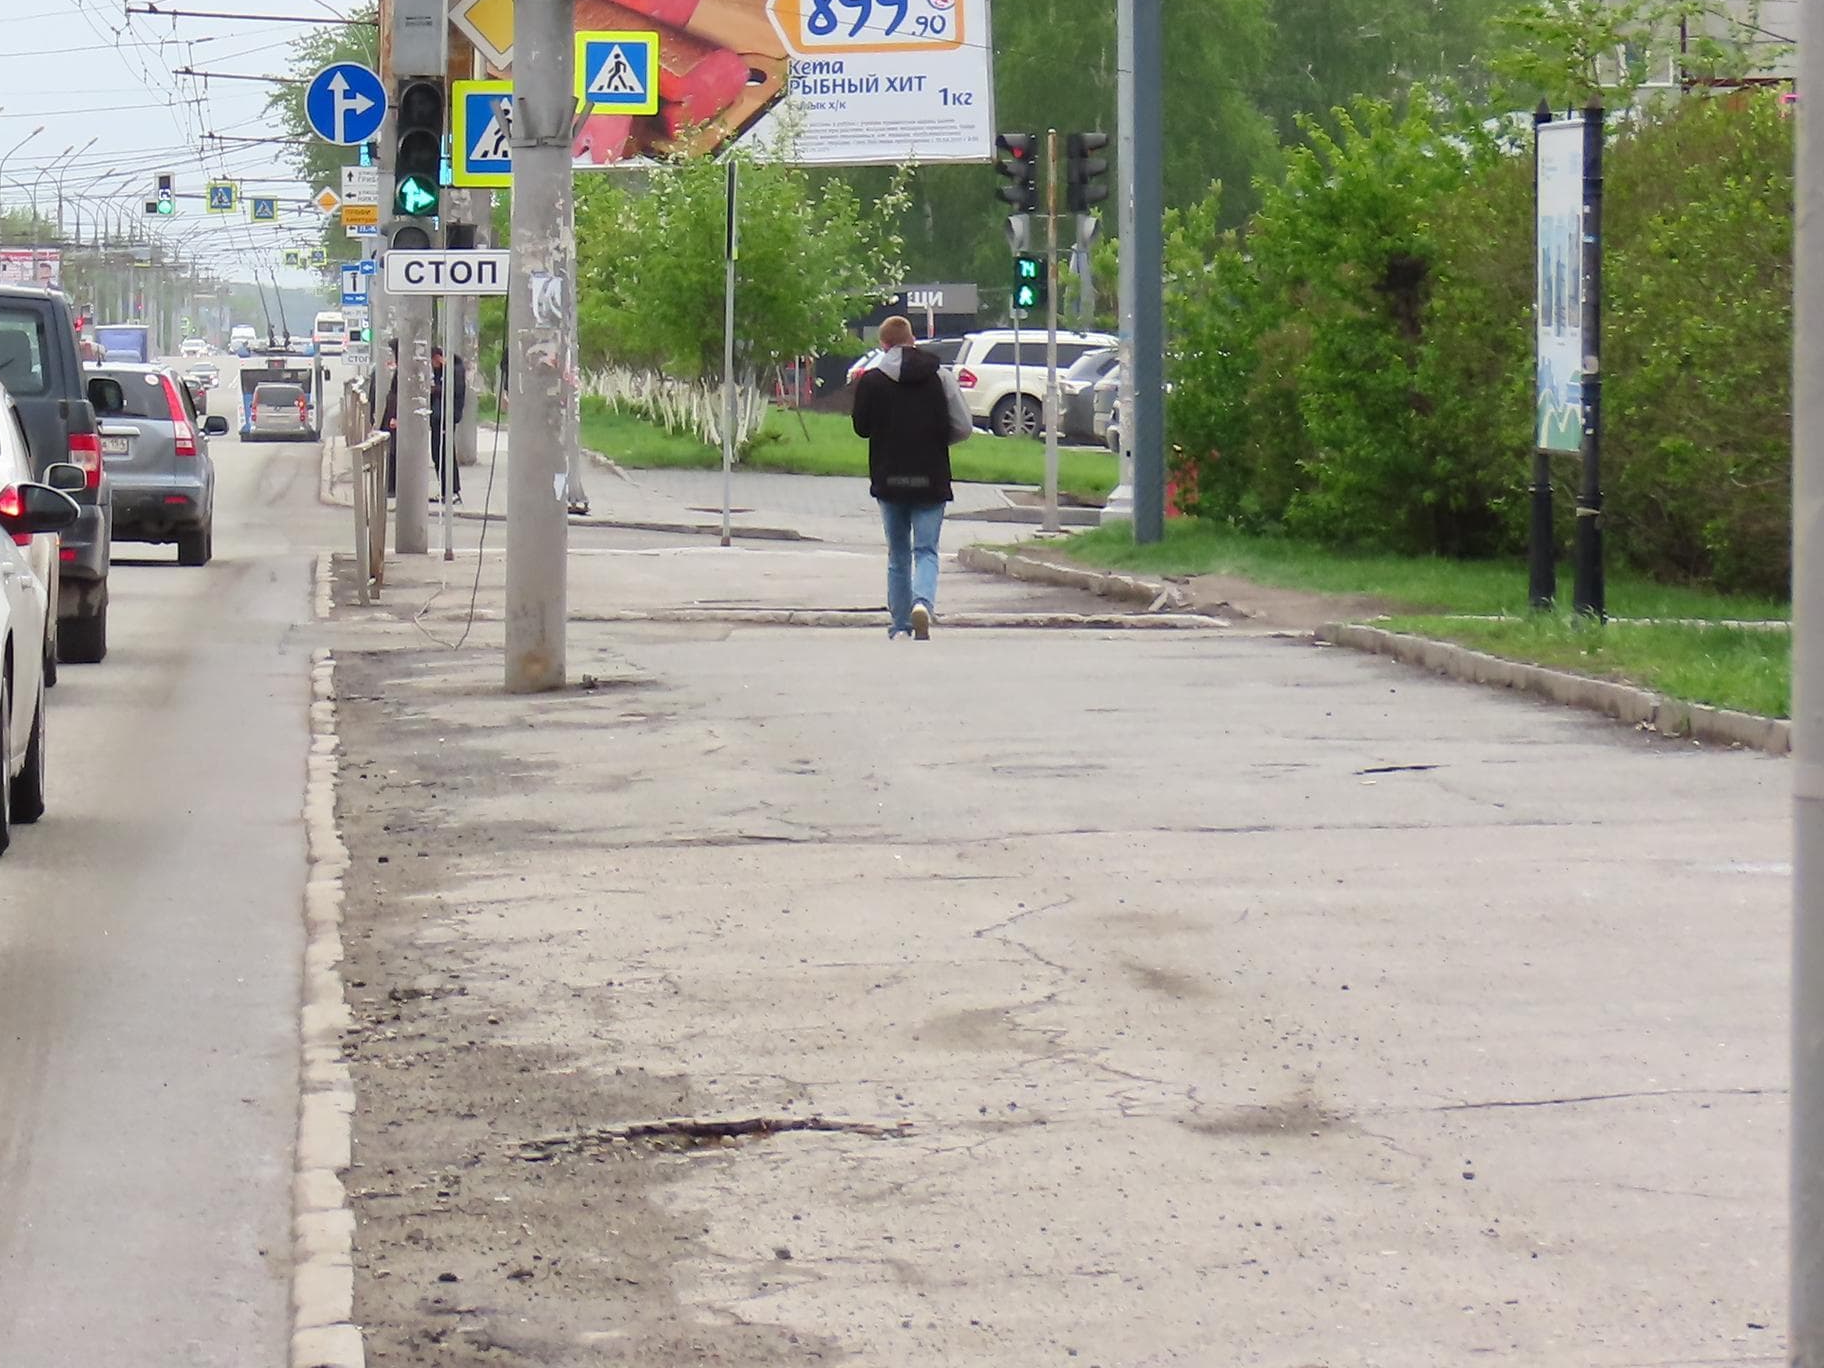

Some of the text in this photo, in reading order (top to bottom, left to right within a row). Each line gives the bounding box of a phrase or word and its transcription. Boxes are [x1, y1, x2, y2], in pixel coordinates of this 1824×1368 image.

[788, 60, 844, 76] Кета
[789, 73, 927, 95] РЫБНЫЙ ХИТ
[403, 260, 498, 285] СТОП
